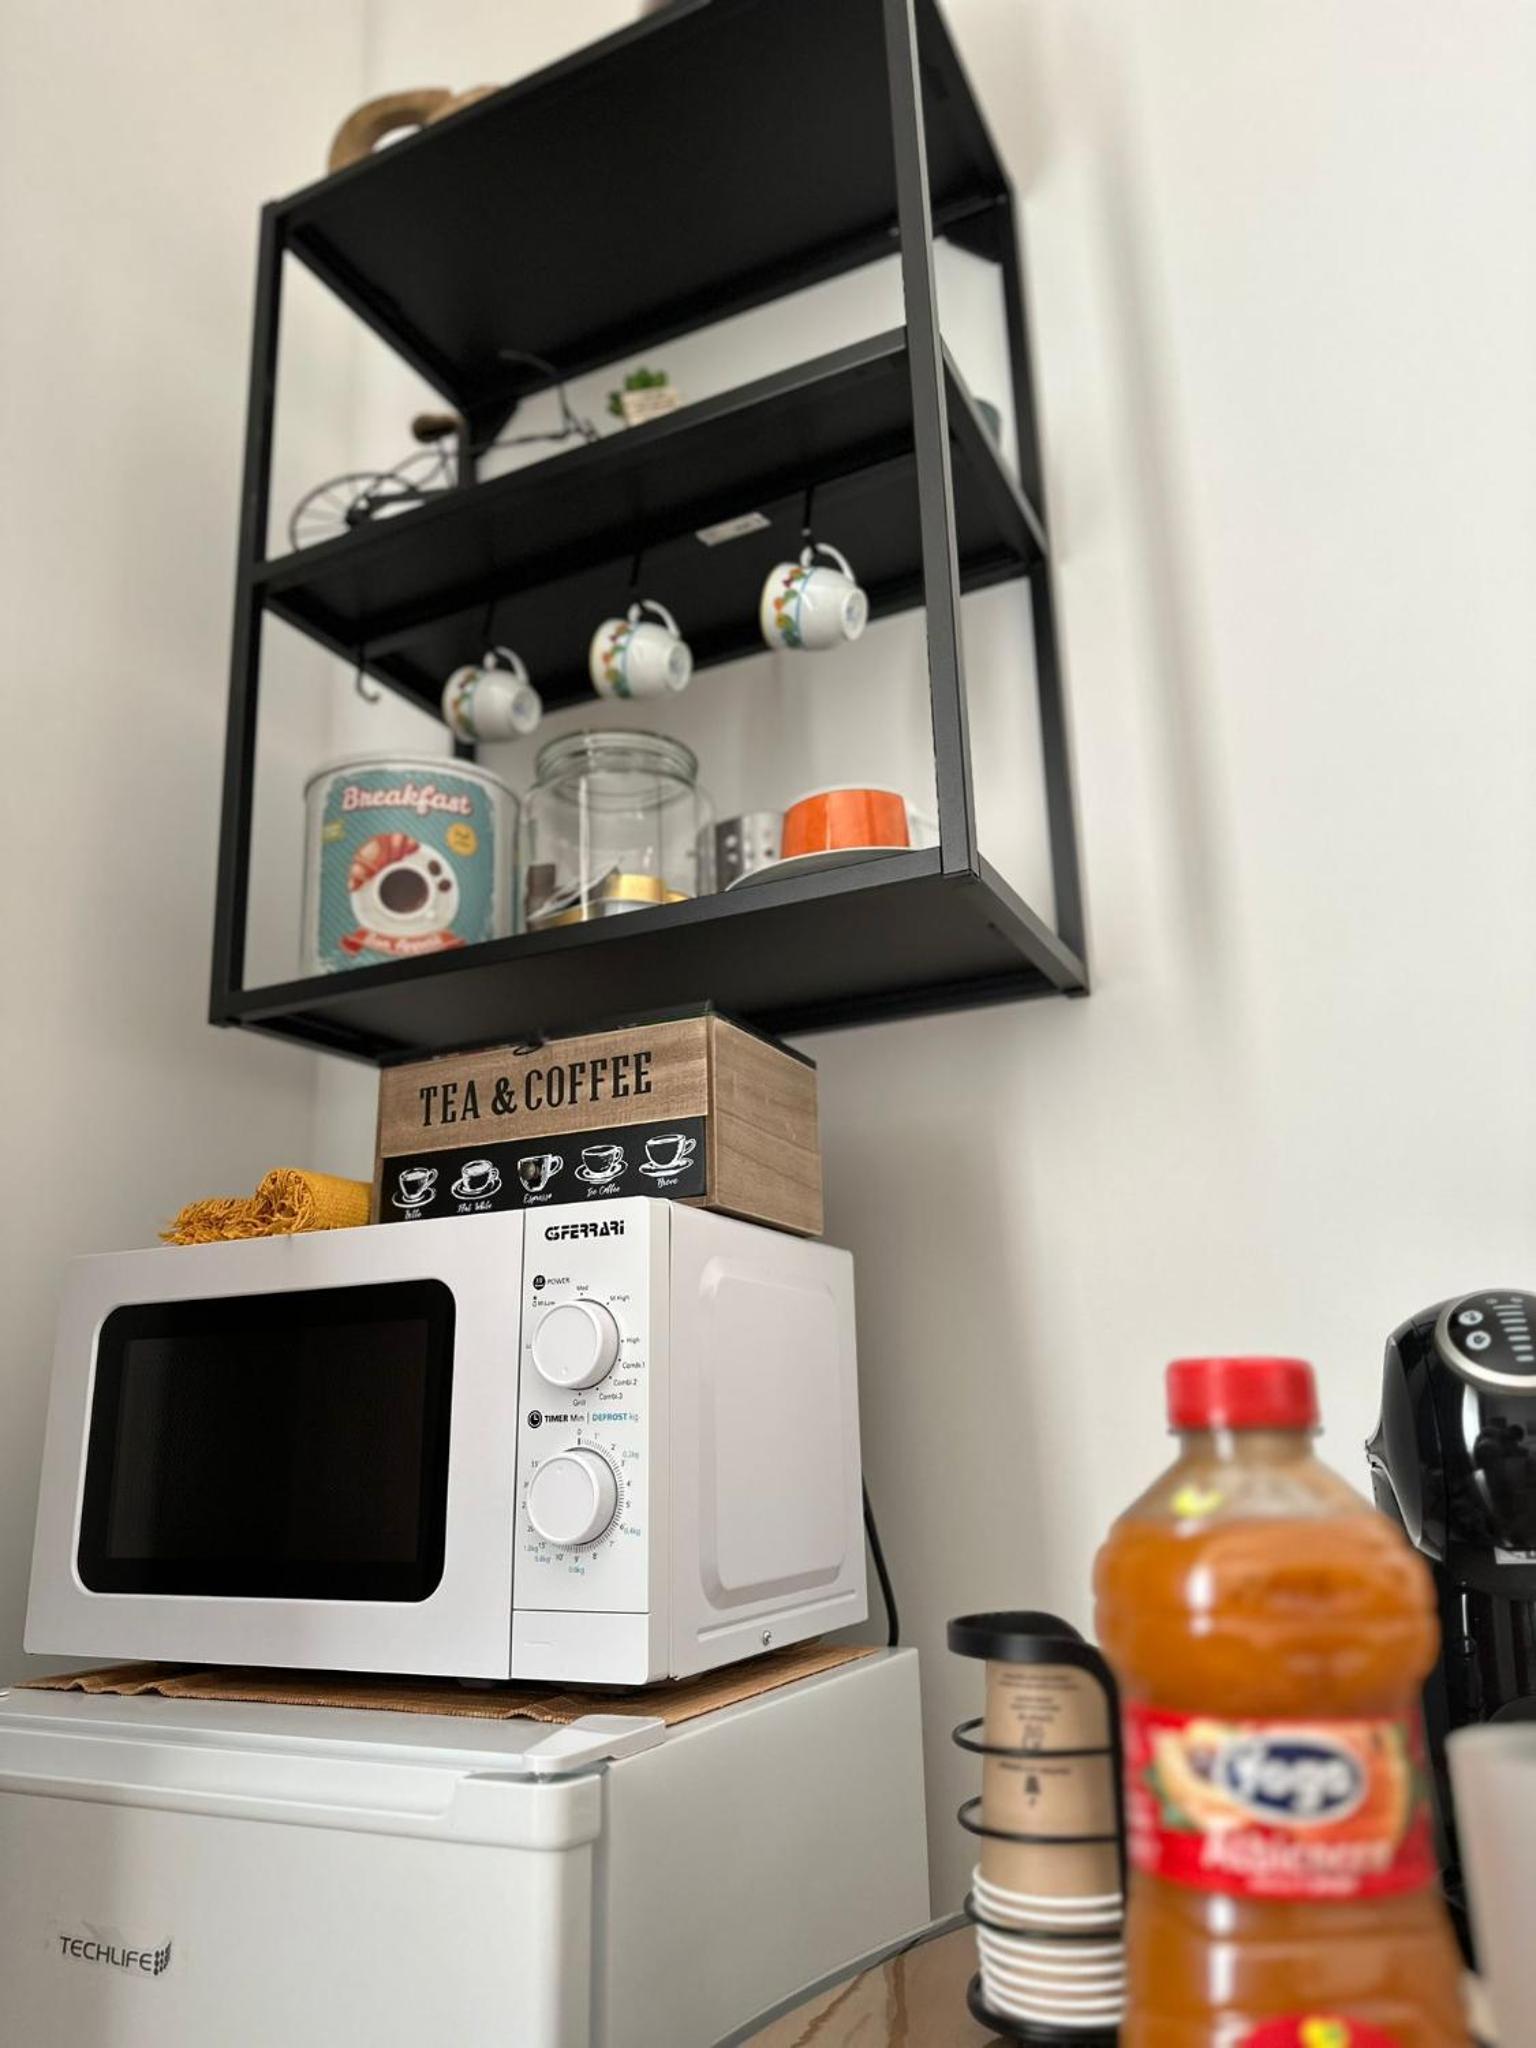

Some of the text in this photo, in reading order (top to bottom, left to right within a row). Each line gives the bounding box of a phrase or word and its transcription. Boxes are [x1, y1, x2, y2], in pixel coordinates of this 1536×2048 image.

[342, 783, 473, 815] Breakfast
[420, 1051, 652, 1126] TEA & COFFEE
[547, 1277, 571, 1286] POWER
[544, 1414, 569, 1423] TIMER
[592, 1412, 628, 1422] DEFROST
[60, 1936, 152, 1972] TECHLIFE
